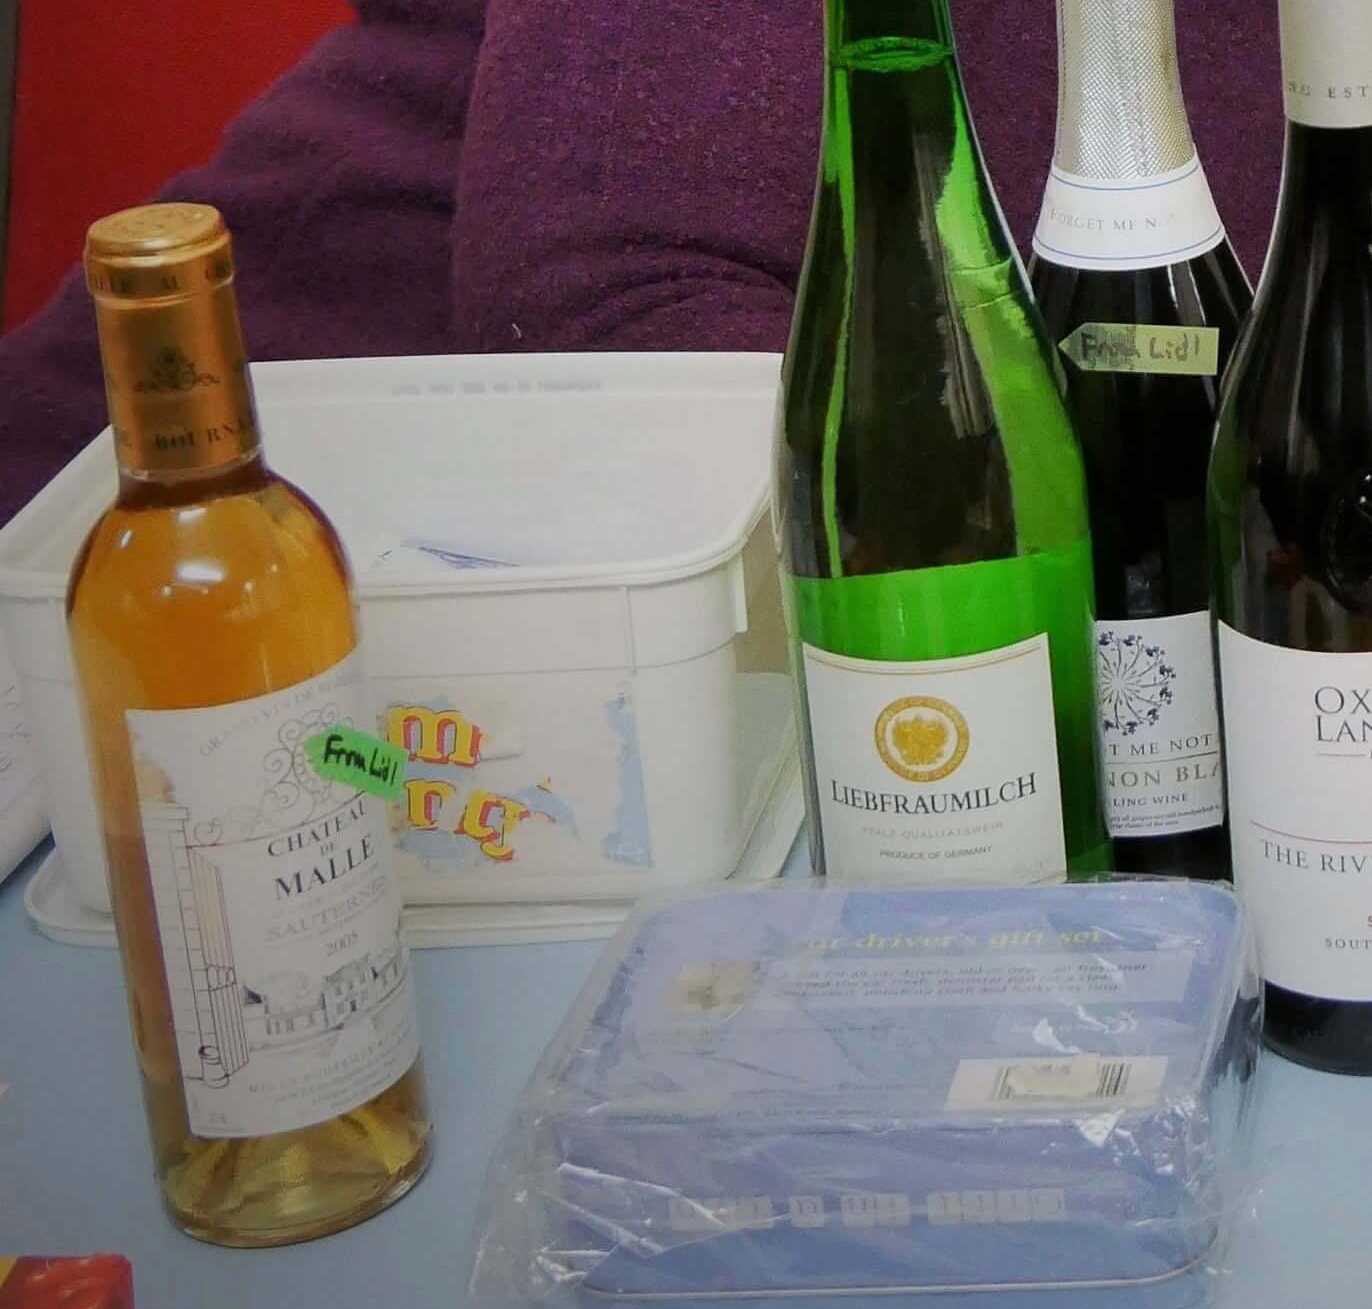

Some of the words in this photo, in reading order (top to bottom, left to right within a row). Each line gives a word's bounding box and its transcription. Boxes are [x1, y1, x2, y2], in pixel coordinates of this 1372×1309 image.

[1149, 332, 1200, 363] Lidl
[1130, 743, 1160, 757] ME
[1169, 732, 1213, 752] NOT
[830, 771, 1037, 815] LIEBFRAUMILCH
[1152, 793, 1188, 805] WINE
[274, 832, 374, 901] MALLE
[879, 849, 924, 861] PRODUCE
[927, 850, 941, 860] OF
[943, 845, 992, 860] GERMANY
[1260, 838, 1309, 870] THE
[855, 930, 980, 950] driver's
[988, 930, 1044, 949] gift
